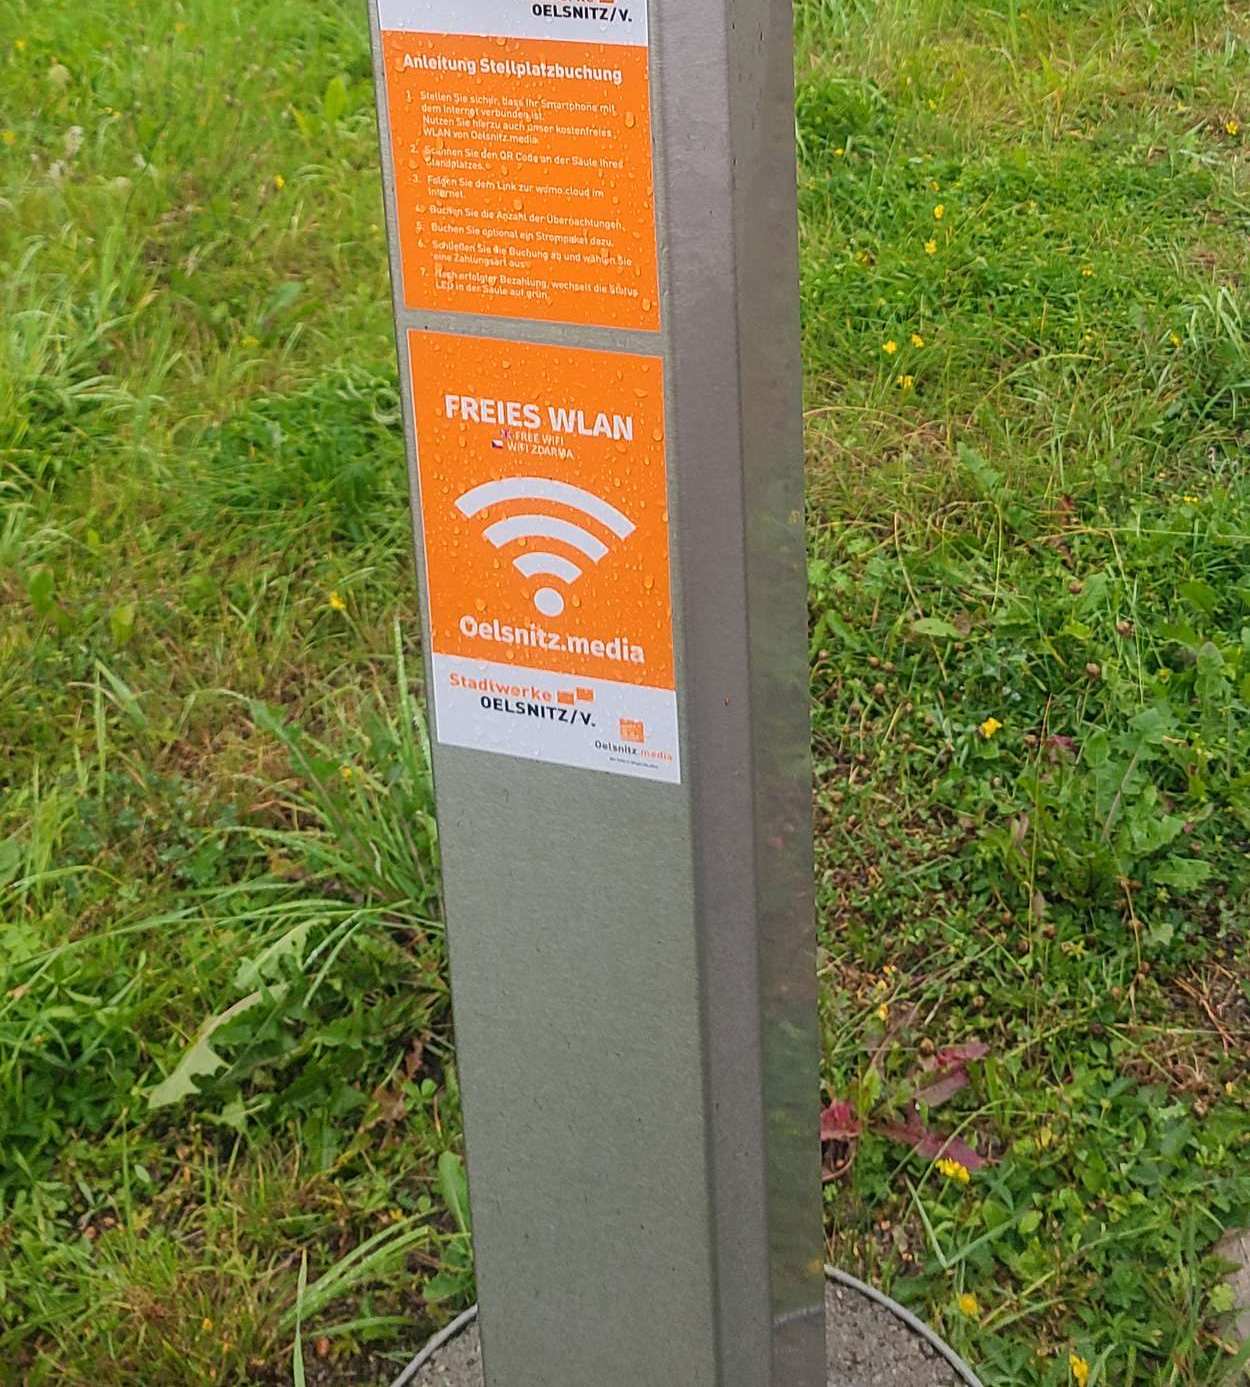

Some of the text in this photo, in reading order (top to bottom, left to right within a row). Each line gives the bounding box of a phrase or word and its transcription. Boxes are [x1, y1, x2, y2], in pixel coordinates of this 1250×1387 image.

[532, 3, 633, 23] OELSNITZ/V.
[402, 53, 623, 85] Anleitung Stellplatzbuchung
[420, 91, 452, 102] Stellen
[453, 92, 468, 103] Sie
[526, 98, 538, 108] Ihr
[540, 99, 598, 112] Smartphone
[599, 103, 616, 113] mit
[421, 103, 441, 113] dem
[481, 108, 530, 120] verbunden
[422, 115, 454, 126] Nutzen
[456, 117, 470, 127] Sie
[472, 119, 500, 129] hierzu
[503, 121, 525, 131] auch
[556, 124, 612, 137] kostenfreies
[423, 127, 451, 138] WLAN
[453, 131, 469, 139] von
[464, 148, 479, 158] Sie
[481, 149, 498, 159] den
[500, 151, 513, 161] QR
[554, 155, 570, 165] der
[427, 175, 457, 187] Folgen
[459, 177, 473, 187] Sie
[475, 179, 495, 189] dem
[497, 181, 516, 191] Link
[518, 184, 533, 192] zur
[565, 186, 589, 197] cloud
[592, 188, 604, 197] im
[464, 207, 479, 217] Sie
[481, 209, 494, 219] die
[497, 211, 527, 221] Anzahl
[529, 213, 545, 222] der
[431, 222, 464, 234] Buchen
[466, 225, 480, 235] Sie
[482, 228, 518, 239] optional
[520, 231, 534, 241] ein
[535, 231, 588, 245] Strompaket
[433, 253, 453, 262] eine
[454, 254, 507, 267] Zahlungsart
[477, 243, 491, 254] Sie
[492, 244, 507, 254] die
[509, 247, 548, 261] Buchung
[550, 251, 562, 261] ab
[564, 253, 581, 262] und
[435, 280, 454, 292] LED
[455, 283, 464, 292] in
[466, 283, 481, 293] der
[510, 287, 524, 296] auf
[551, 281, 591, 293] wechselt
[593, 284, 607, 293] die
[445, 394, 634, 441] FREIES WLAN
[514, 431, 540, 444] FREE
[531, 444, 575, 460] ZDARMA
[459, 615, 645, 664] Oelsnitz.media
[449, 672, 553, 701] Stadtwerke
[480, 695, 597, 727] OELSNITZ/V.
